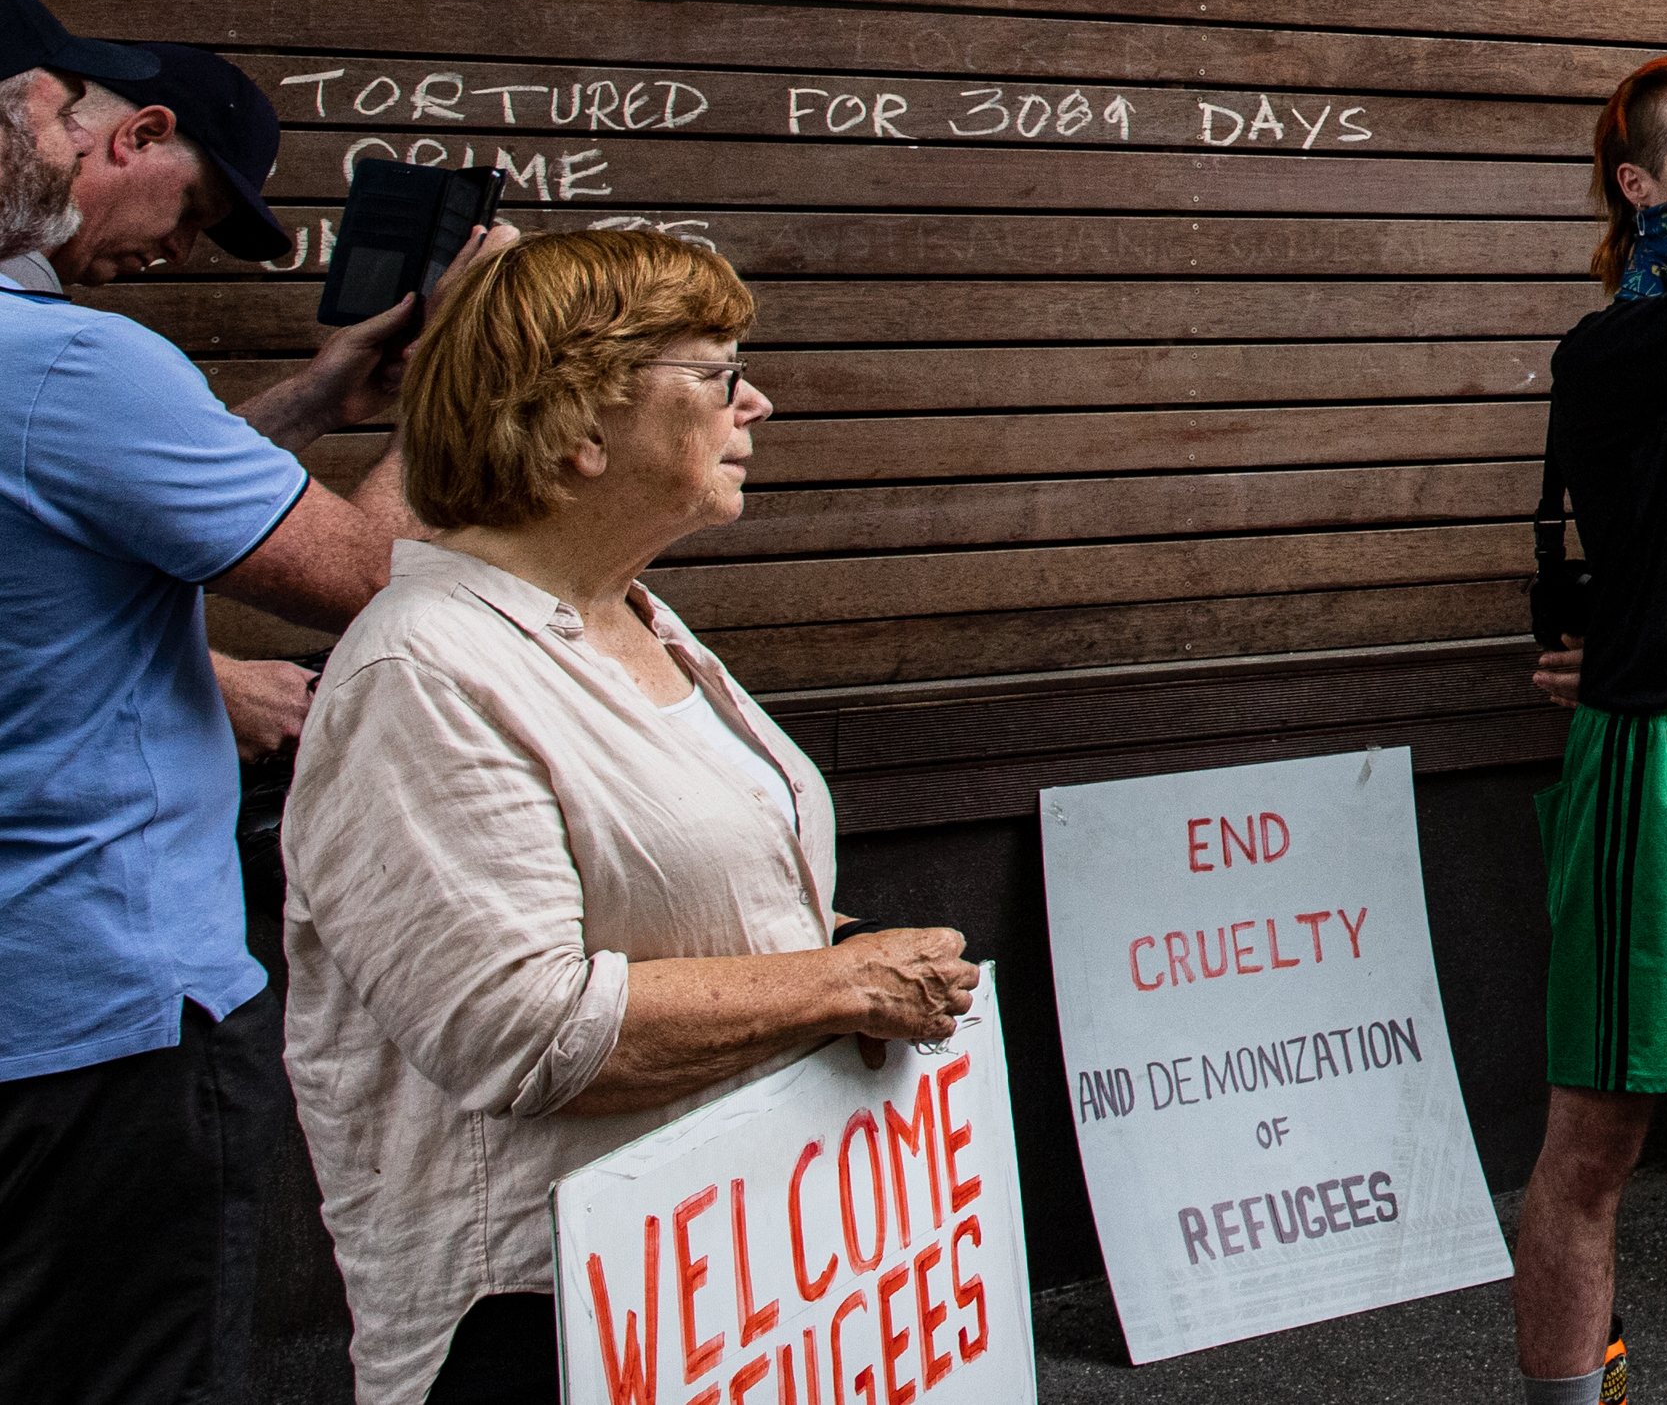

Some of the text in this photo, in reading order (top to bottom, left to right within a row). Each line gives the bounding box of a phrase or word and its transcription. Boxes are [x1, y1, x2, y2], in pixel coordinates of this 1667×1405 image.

[281, 68, 1373, 148] TORTURED FOR 3089 DAYS
[1187, 812, 1291, 873] END
[1129, 907, 1368, 992] CRUELTY
[1079, 1017, 1423, 1125] AND DEMONIZATION
[1256, 1116, 1291, 1150] OF
[586, 1050, 984, 1405] WELCOME
[1177, 1170, 1400, 1267] REFUGEES
